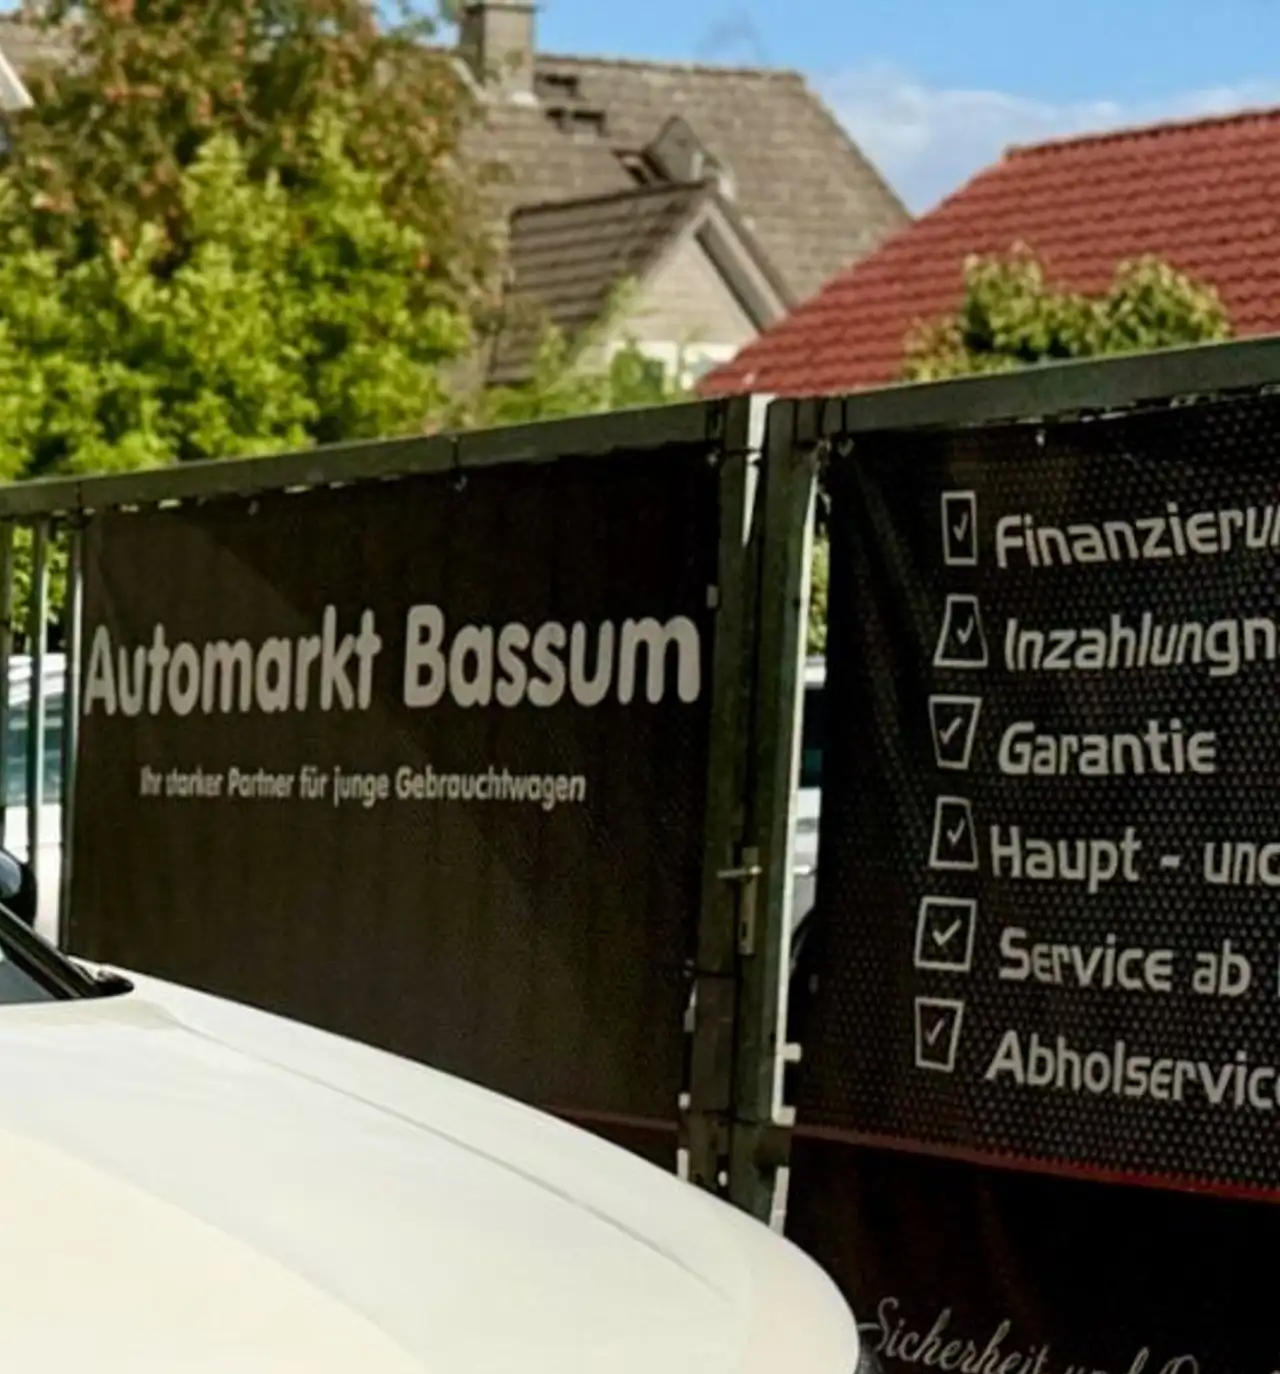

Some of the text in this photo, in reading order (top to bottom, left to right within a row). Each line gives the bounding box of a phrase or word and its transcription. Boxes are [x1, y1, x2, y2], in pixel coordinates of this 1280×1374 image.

[84, 604, 701, 716] Automarkt Bassum
[1004, 612, 1280, 676] Inzahlungn
[998, 718, 1217, 775] Garantie
[140, 763, 586, 812] Ihr starker Partner für junge Gebrauchtwagen
[990, 825, 1142, 893] Haupt
[998, 926, 1252, 996] Service ab
